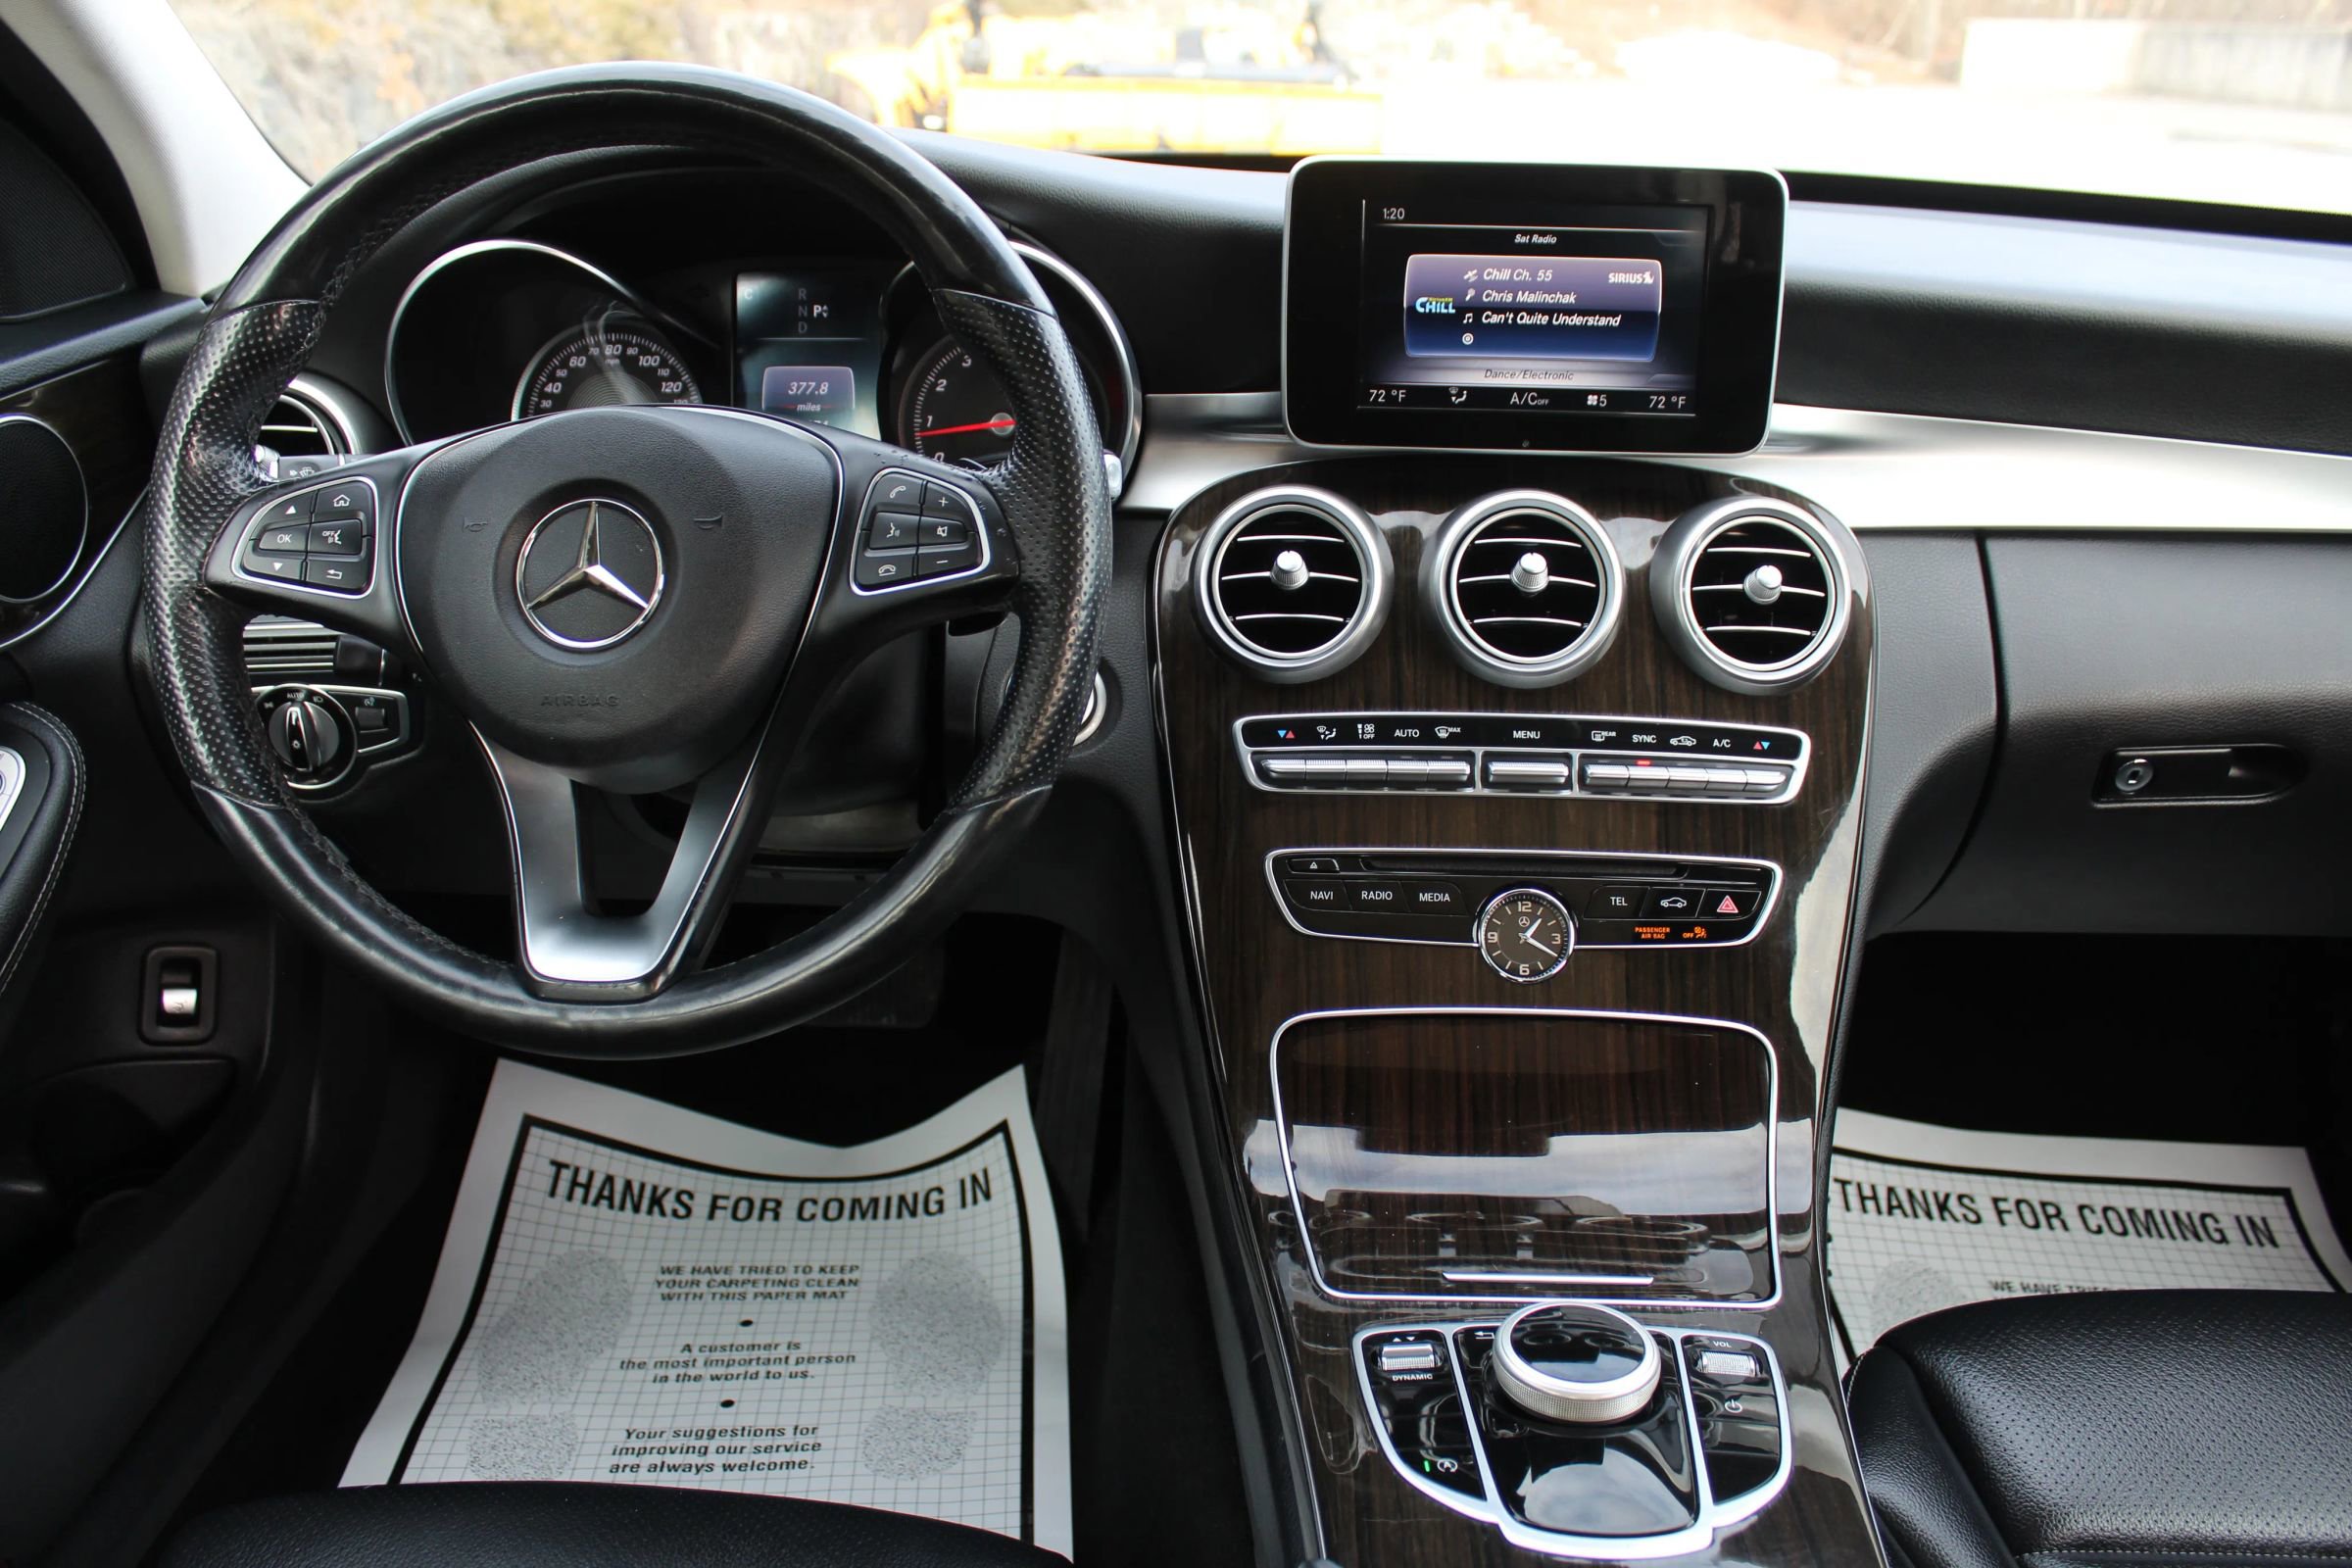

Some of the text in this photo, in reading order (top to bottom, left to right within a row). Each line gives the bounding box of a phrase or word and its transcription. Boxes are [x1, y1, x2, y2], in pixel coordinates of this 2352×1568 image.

[1383, 208, 1405, 220] 1:20
[1515, 233, 1557, 245] Sat Radio
[1483, 268, 1552, 281] Chill Ch. 55
[1608, 272, 1642, 284] SIRIUS
[744, 287, 753, 299] C
[799, 288, 807, 301] R
[1482, 289, 1577, 304] Chris Malinchak
[813, 305, 822, 318] P
[1415, 297, 1456, 314] CHILL
[799, 306, 808, 318] N
[1482, 312, 1621, 327] Can't Quite Understand
[799, 321, 808, 333] D
[605, 344, 622, 355] 80
[569, 356, 587, 368] 60
[638, 355, 661, 367] 100
[961, 354, 972, 368] 3
[658, 368, 670, 376] 110
[1485, 368, 1574, 382] Dance/Electronic
[544, 381, 563, 393] 40
[661, 381, 682, 393] 120
[788, 381, 829, 395] 377.8
[936, 378, 947, 392] 2
[1369, 390, 1387, 402] 72
[1510, 392, 1538, 407] A/C
[1598, 394, 1607, 408] 5
[1649, 395, 1667, 409] 72
[797, 402, 821, 412] miles
[926, 415, 933, 427] 1
[276, 533, 292, 544] OK
[540, 692, 621, 708] AIRBAG
[1394, 728, 1420, 738] AUTO
[1512, 729, 1541, 740] MENU
[1632, 734, 1657, 744] SYNC
[1712, 739, 1732, 748] A/C
[1309, 890, 1334, 902] NAVI
[1360, 890, 1393, 902] RADIO
[1418, 891, 1450, 903] MEDIA
[1609, 896, 1628, 906] TEL
[1517, 901, 1532, 913] 12
[1488, 931, 1498, 944] 9
[1550, 933, 1561, 945] 3
[1519, 963, 1529, 976] 6
[548, 1159, 992, 1222] THANKS FOR COMING IN
[1833, 1177, 2280, 1250] THANKS FOR COMING IN
[660, 1264, 860, 1276] WE HAVE TRIED TO KEEP
[655, 1277, 860, 1289] YOUR CARPETING CLEAN
[1988, 1281, 2017, 1294] WE
[660, 1290, 848, 1301] WITH THIS PAPER MAT
[680, 1341, 802, 1354] A customer is
[1712, 1340, 1733, 1348] VOL
[619, 1353, 857, 1370] the most important person
[652, 1368, 815, 1385] in the world to us.
[1392, 1373, 1434, 1382] DYNAMIC
[625, 1424, 819, 1442] Your suggestions for
[612, 1441, 823, 1458] improving our service
[609, 1457, 816, 1476] are always welcome.
